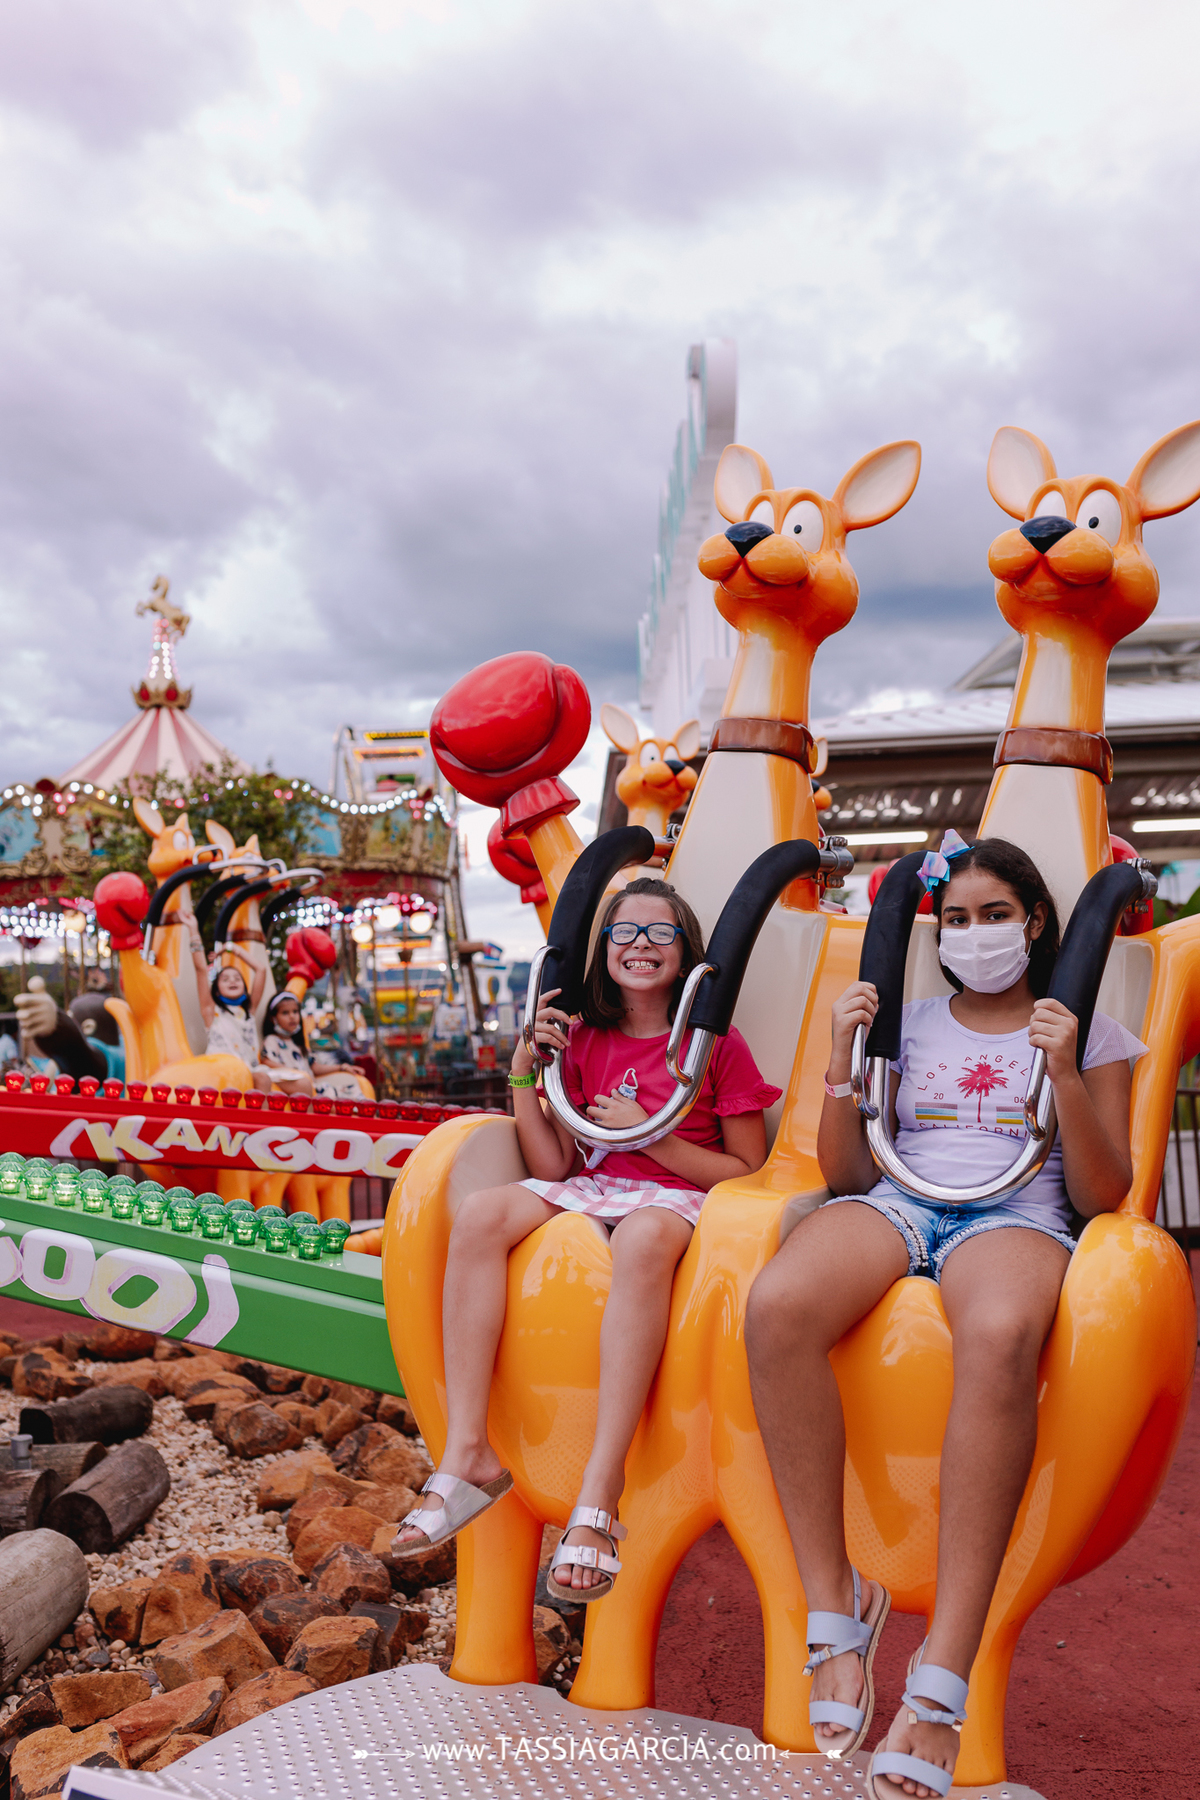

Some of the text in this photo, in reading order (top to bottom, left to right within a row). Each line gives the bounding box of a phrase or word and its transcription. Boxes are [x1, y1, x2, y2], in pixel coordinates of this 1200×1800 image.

[917, 1054, 1029, 1092] LOS ANGEL
[933, 1092, 944, 1100] 20
